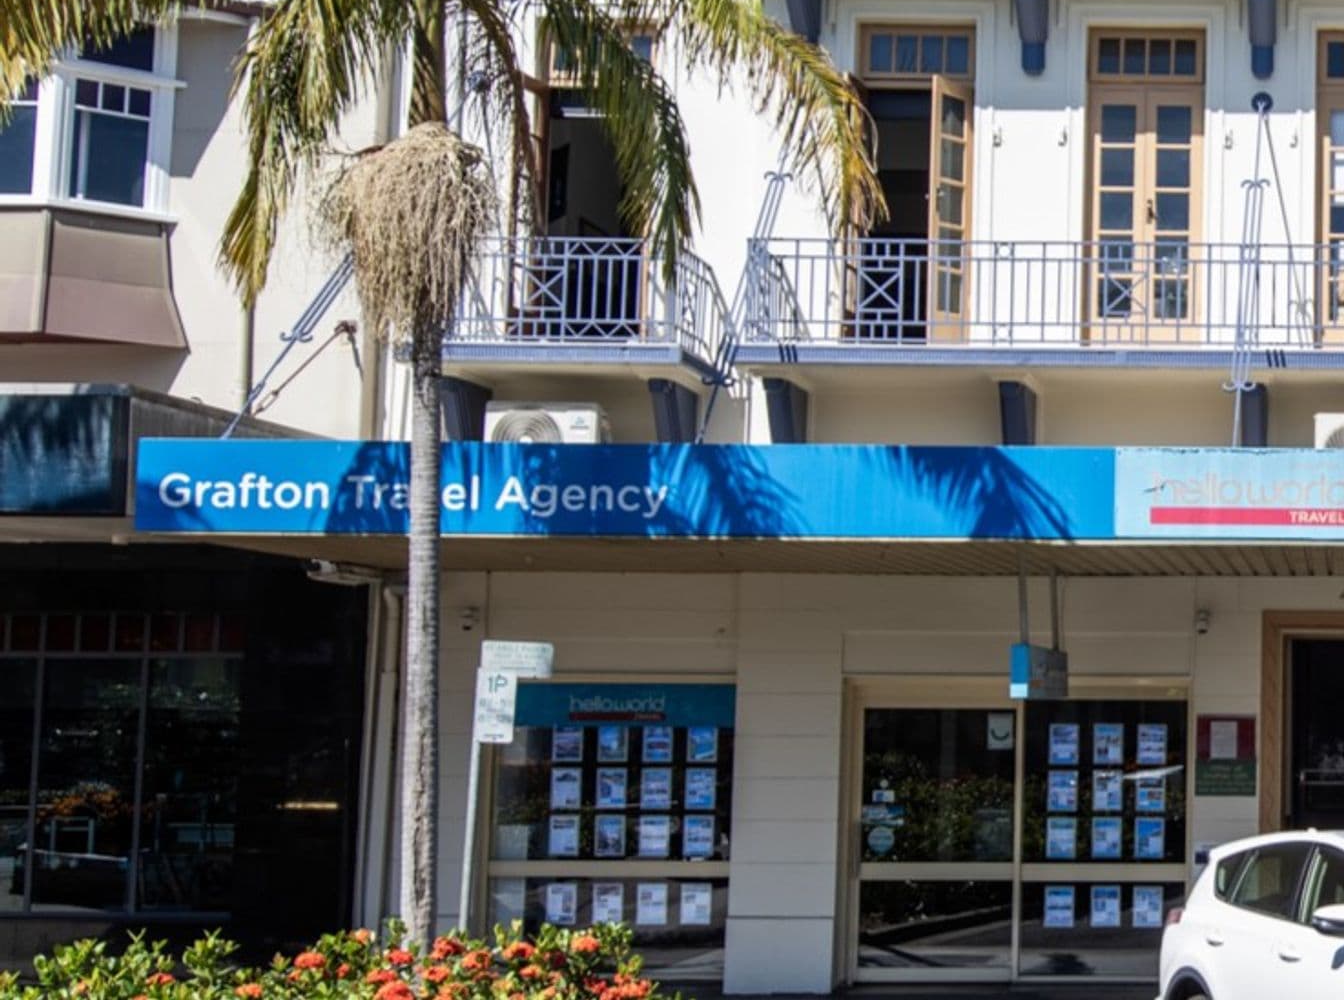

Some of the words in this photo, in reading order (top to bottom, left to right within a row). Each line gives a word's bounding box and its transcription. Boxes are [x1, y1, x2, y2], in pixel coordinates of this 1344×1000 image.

[158, 472, 330, 510] Grafton
[347, 474, 480, 511] Trael
[495, 474, 669, 517] Agency
